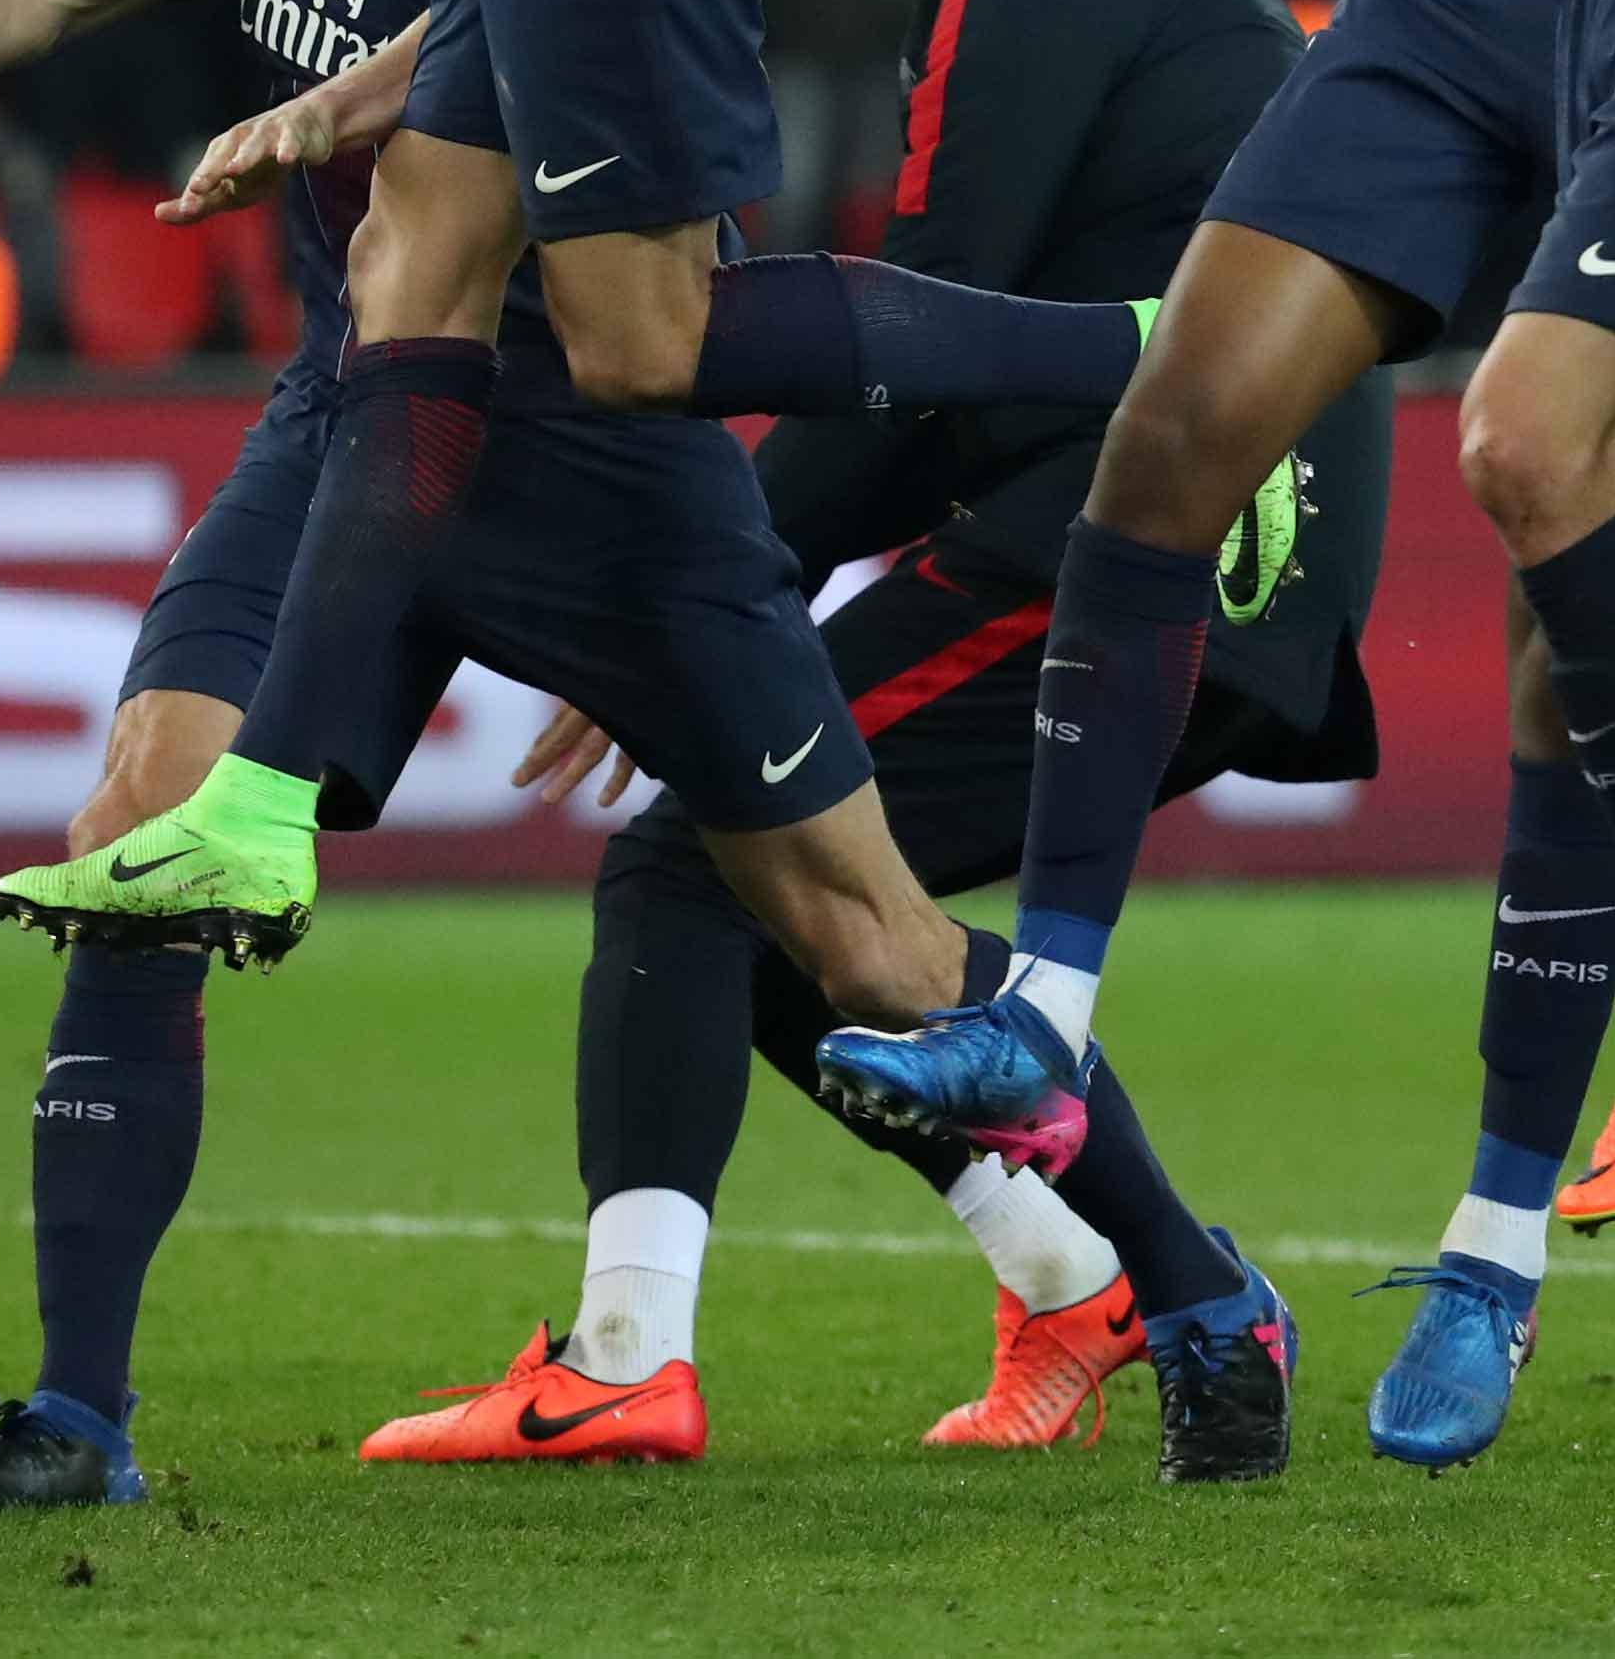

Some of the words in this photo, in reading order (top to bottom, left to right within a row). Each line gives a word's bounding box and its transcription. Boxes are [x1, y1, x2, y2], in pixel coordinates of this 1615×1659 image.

[1034, 708, 1083, 743] RIS
[1492, 949, 1610, 983] PARIS
[32, 1100, 117, 1121] ARIS
